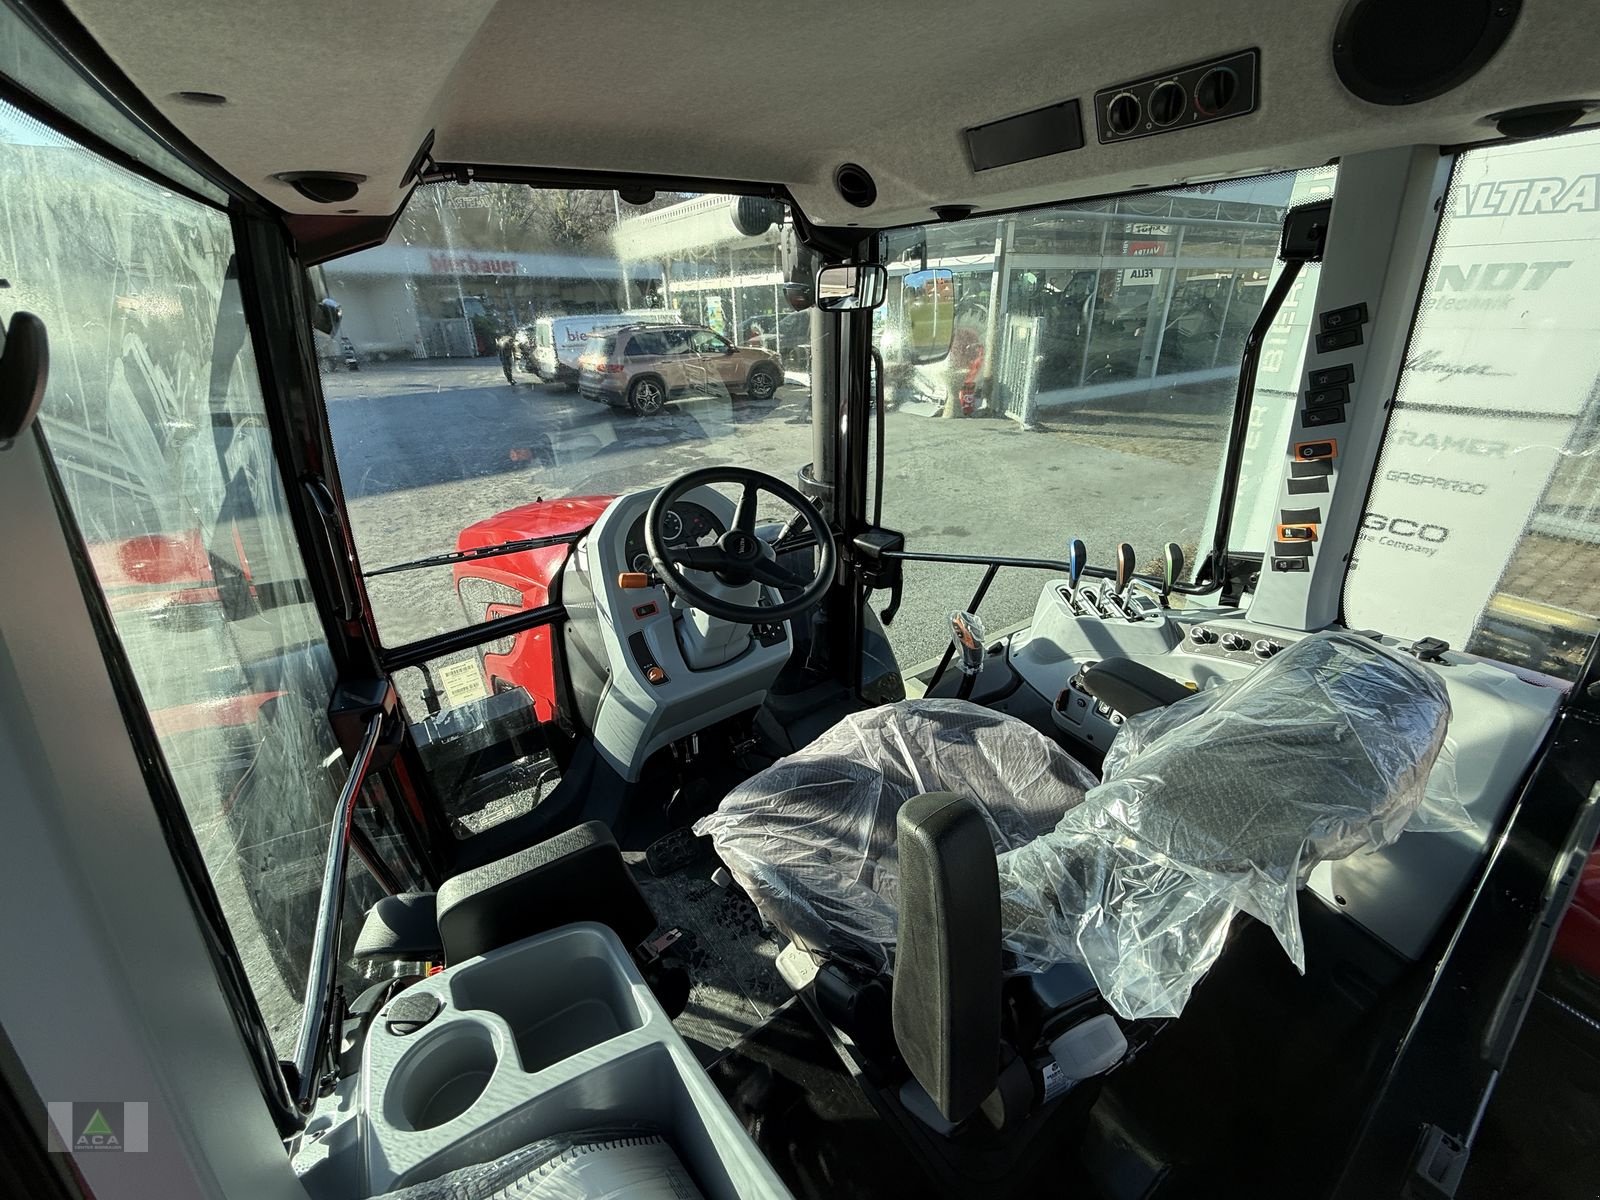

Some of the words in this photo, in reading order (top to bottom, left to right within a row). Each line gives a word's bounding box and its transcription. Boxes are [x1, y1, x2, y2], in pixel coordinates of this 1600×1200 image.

[1433, 260, 1576, 292] NDT
[566, 326, 588, 342] bie
[1395, 429, 1508, 459] RAMER
[1363, 512, 1449, 543] GCO
[1378, 536, 1438, 557] Company
